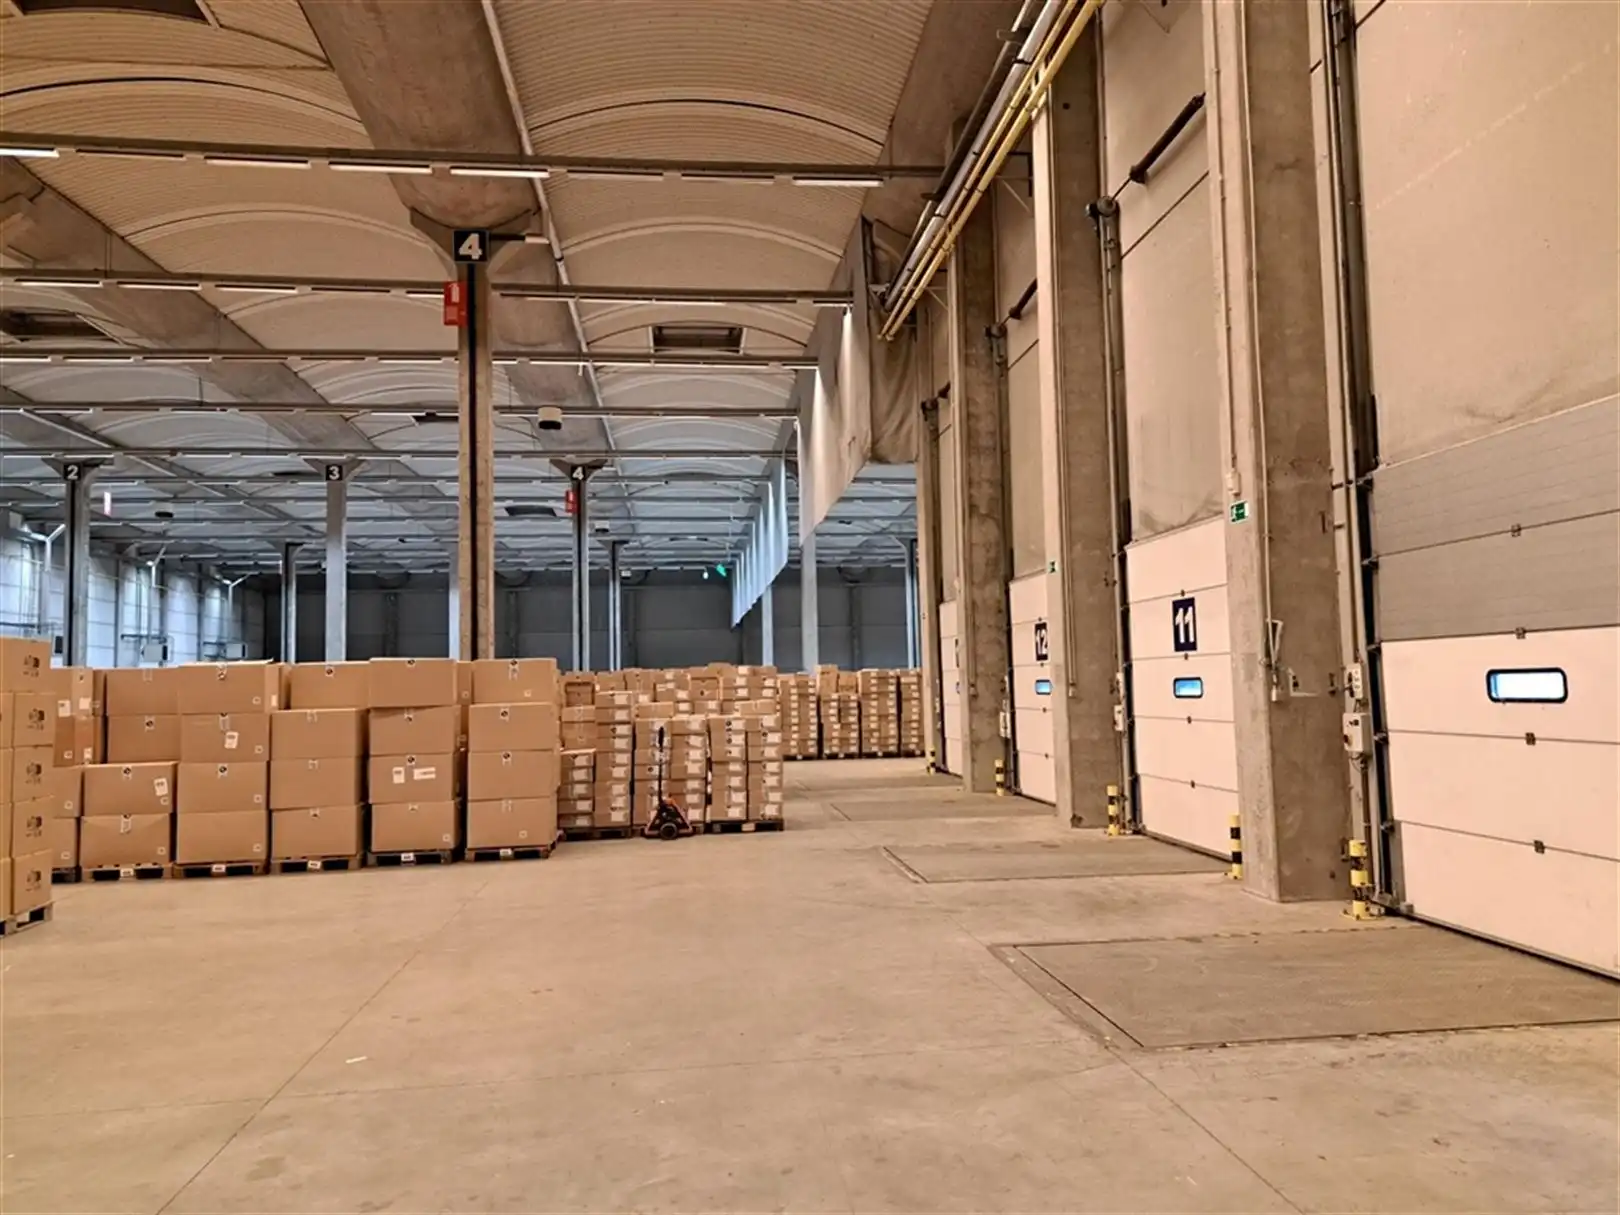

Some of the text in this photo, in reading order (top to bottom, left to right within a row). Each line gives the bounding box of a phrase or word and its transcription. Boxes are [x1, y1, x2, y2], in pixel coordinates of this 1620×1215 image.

[458, 232, 483, 260] 4
[67, 464, 79, 480] 2
[329, 465, 340, 480] 3
[572, 466, 584, 480] 4
[1175, 606, 1195, 643] 11
[1036, 629, 1048, 655] 12
